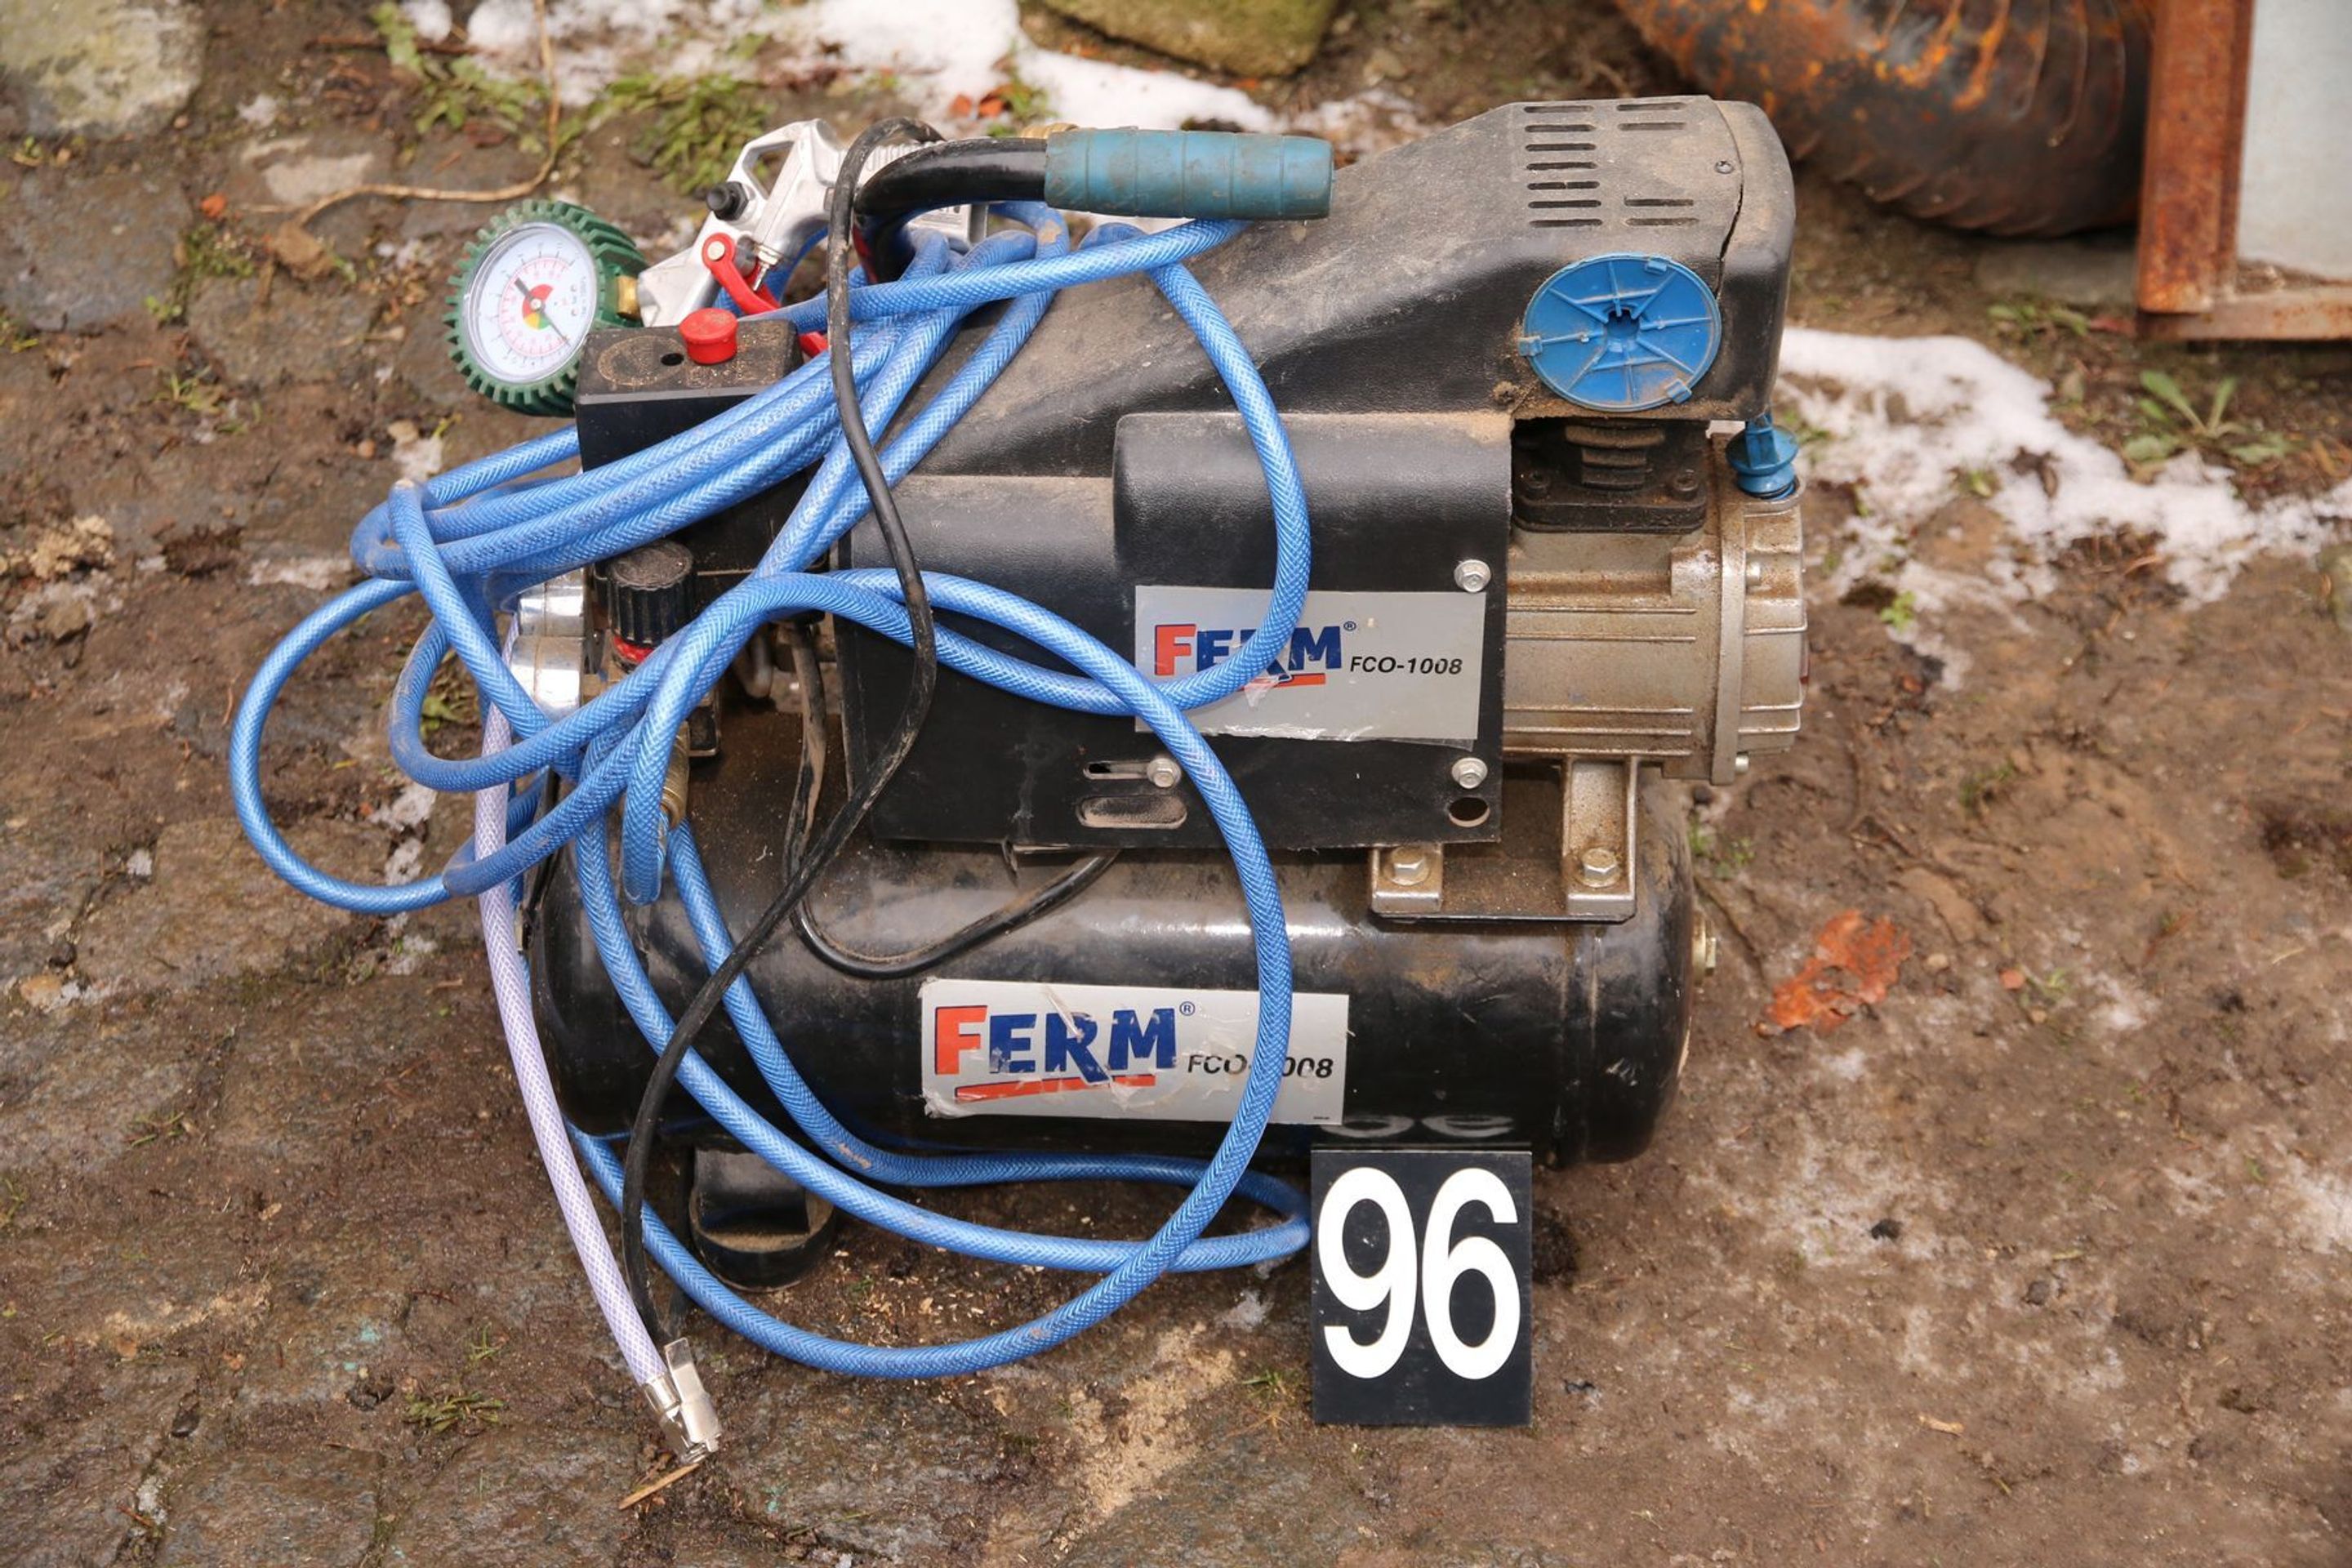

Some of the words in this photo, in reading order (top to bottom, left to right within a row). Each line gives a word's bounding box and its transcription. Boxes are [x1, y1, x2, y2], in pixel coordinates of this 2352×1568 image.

[1349, 656, 1463, 675] FCO-1008
[935, 1004, 1177, 1083] FERM
[1187, 1054, 1334, 1079] FCO008
[1317, 1166, 1521, 1379] 96
